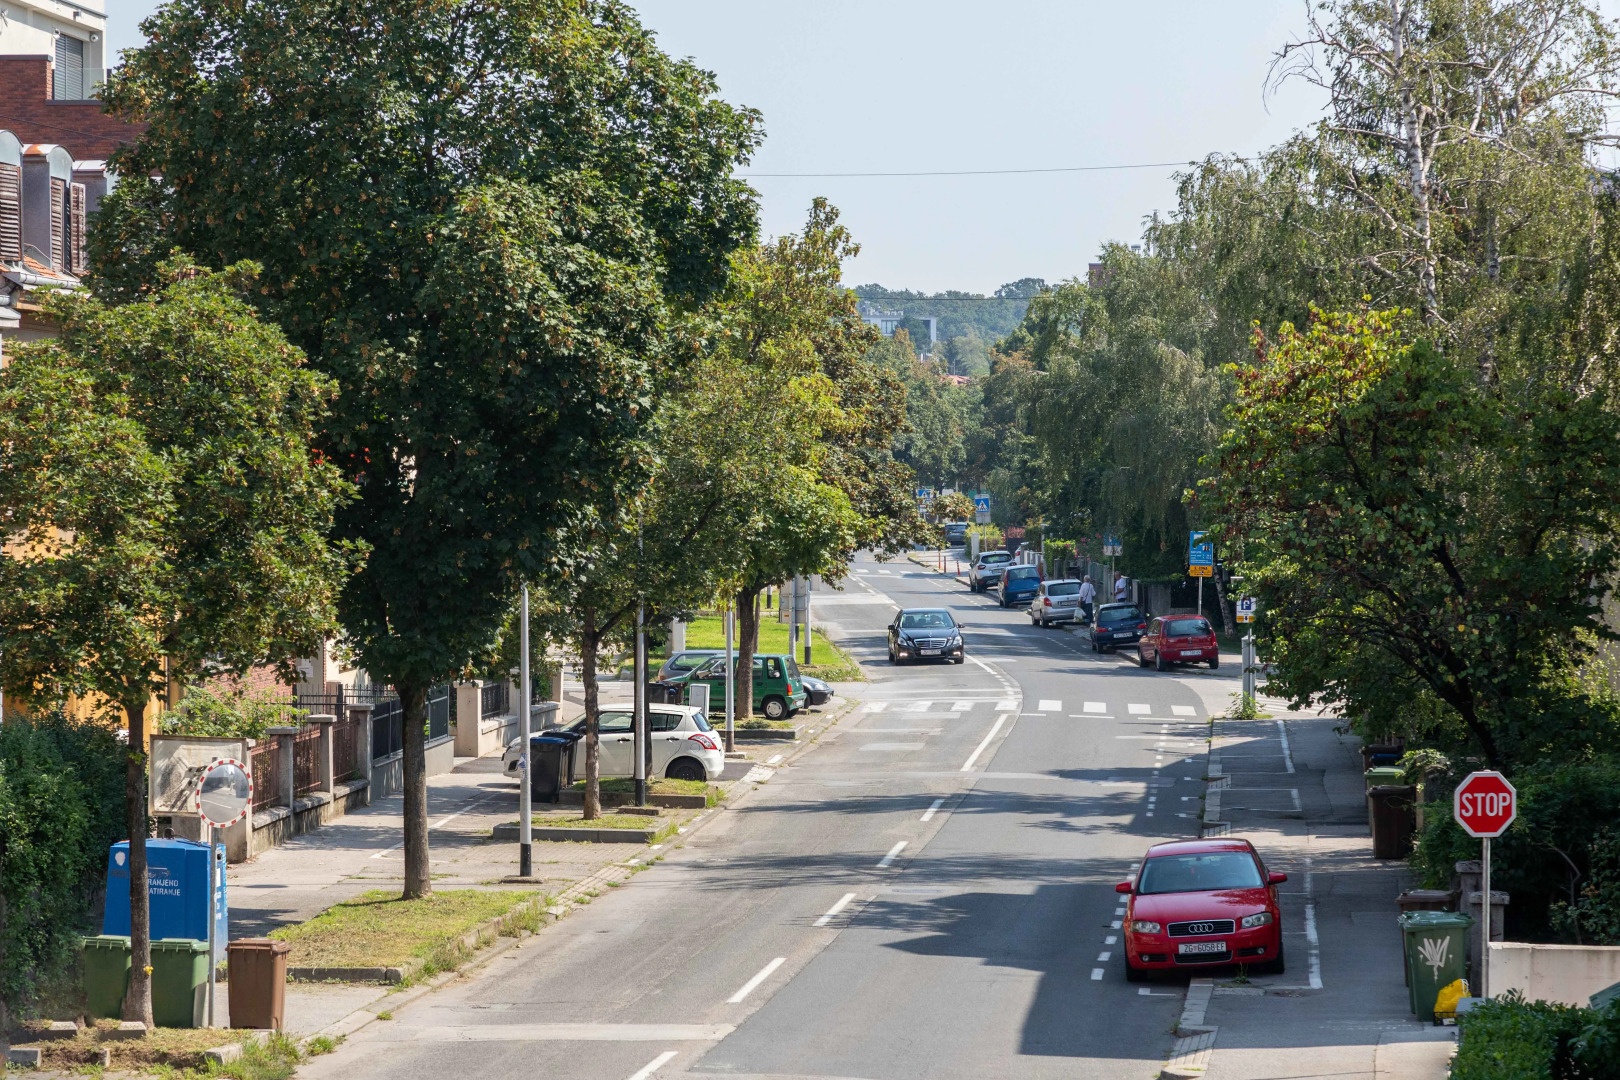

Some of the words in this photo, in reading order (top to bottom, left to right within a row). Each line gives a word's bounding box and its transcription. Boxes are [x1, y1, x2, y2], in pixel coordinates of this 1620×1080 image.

[1461, 792, 1511, 817] STOP
[148, 878, 179, 887] RANJENO
[149, 887, 181, 896] ATIRANJE
[1184, 944, 1194, 953] ZG
